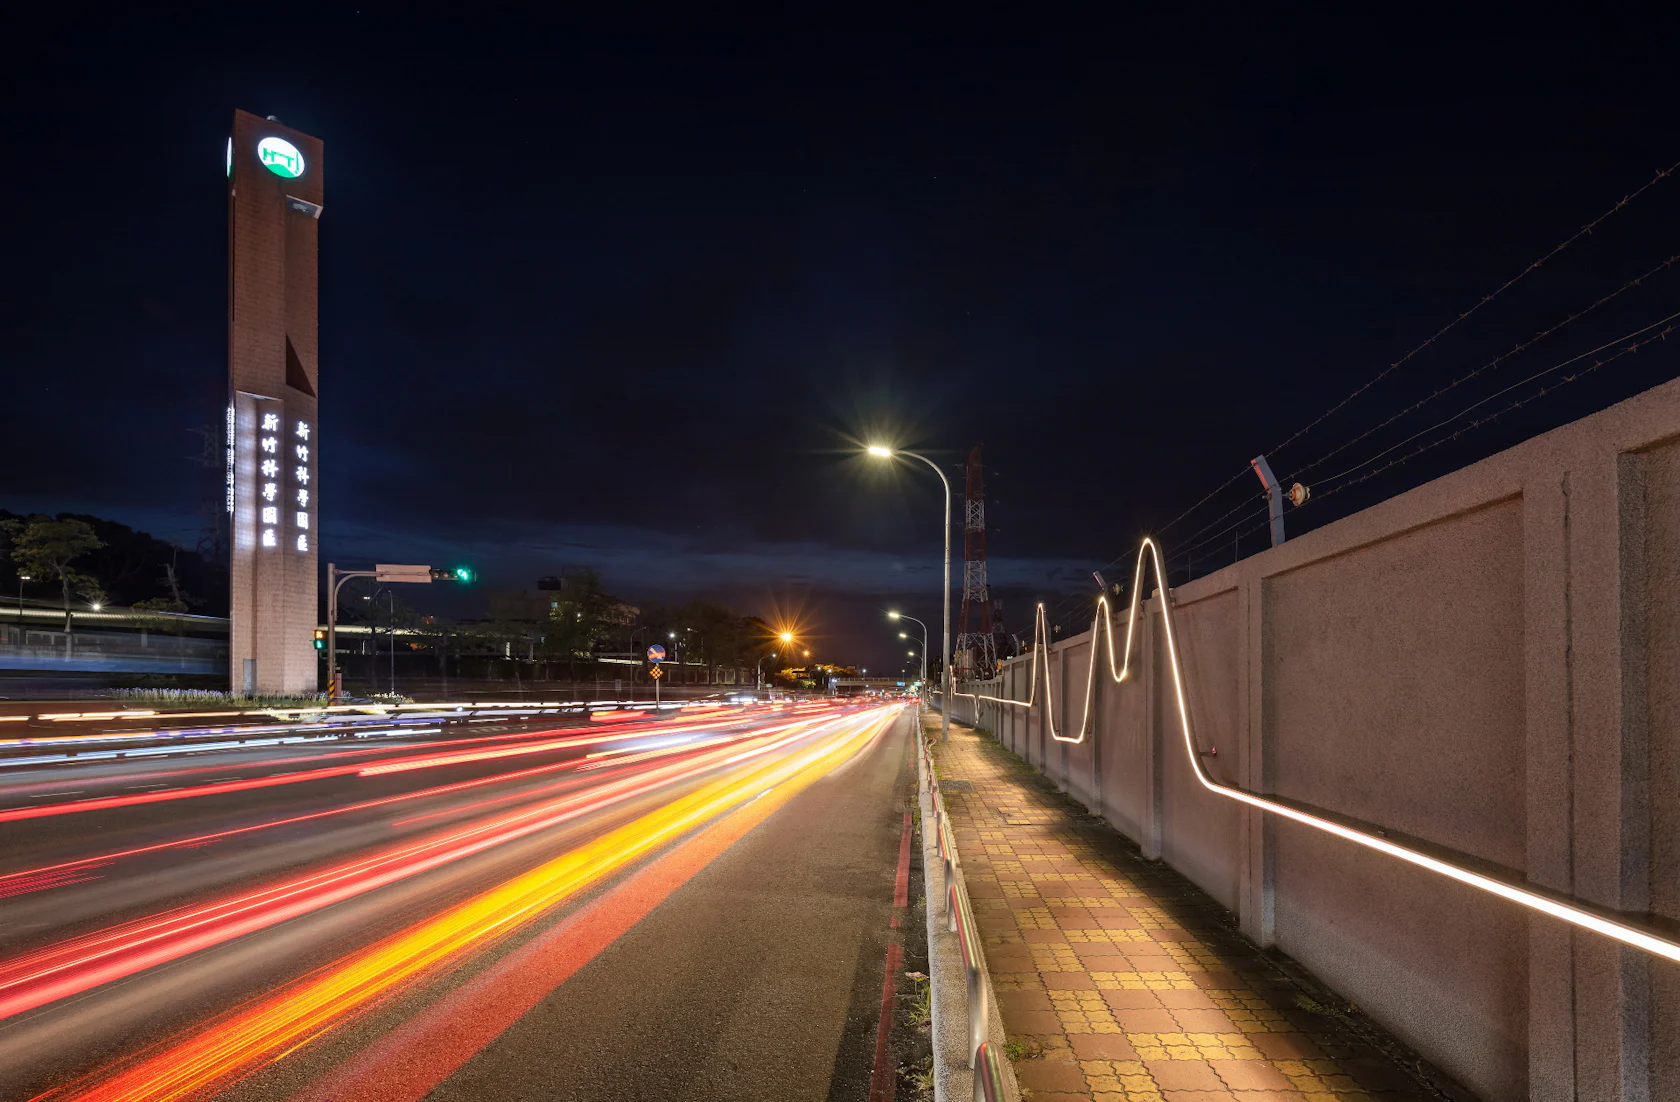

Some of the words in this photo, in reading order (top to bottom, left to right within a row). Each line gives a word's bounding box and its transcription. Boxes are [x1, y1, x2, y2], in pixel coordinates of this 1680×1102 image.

[261, 413, 279, 547] 新竹科學園區
[296, 421, 310, 552] 新竹科學園區
